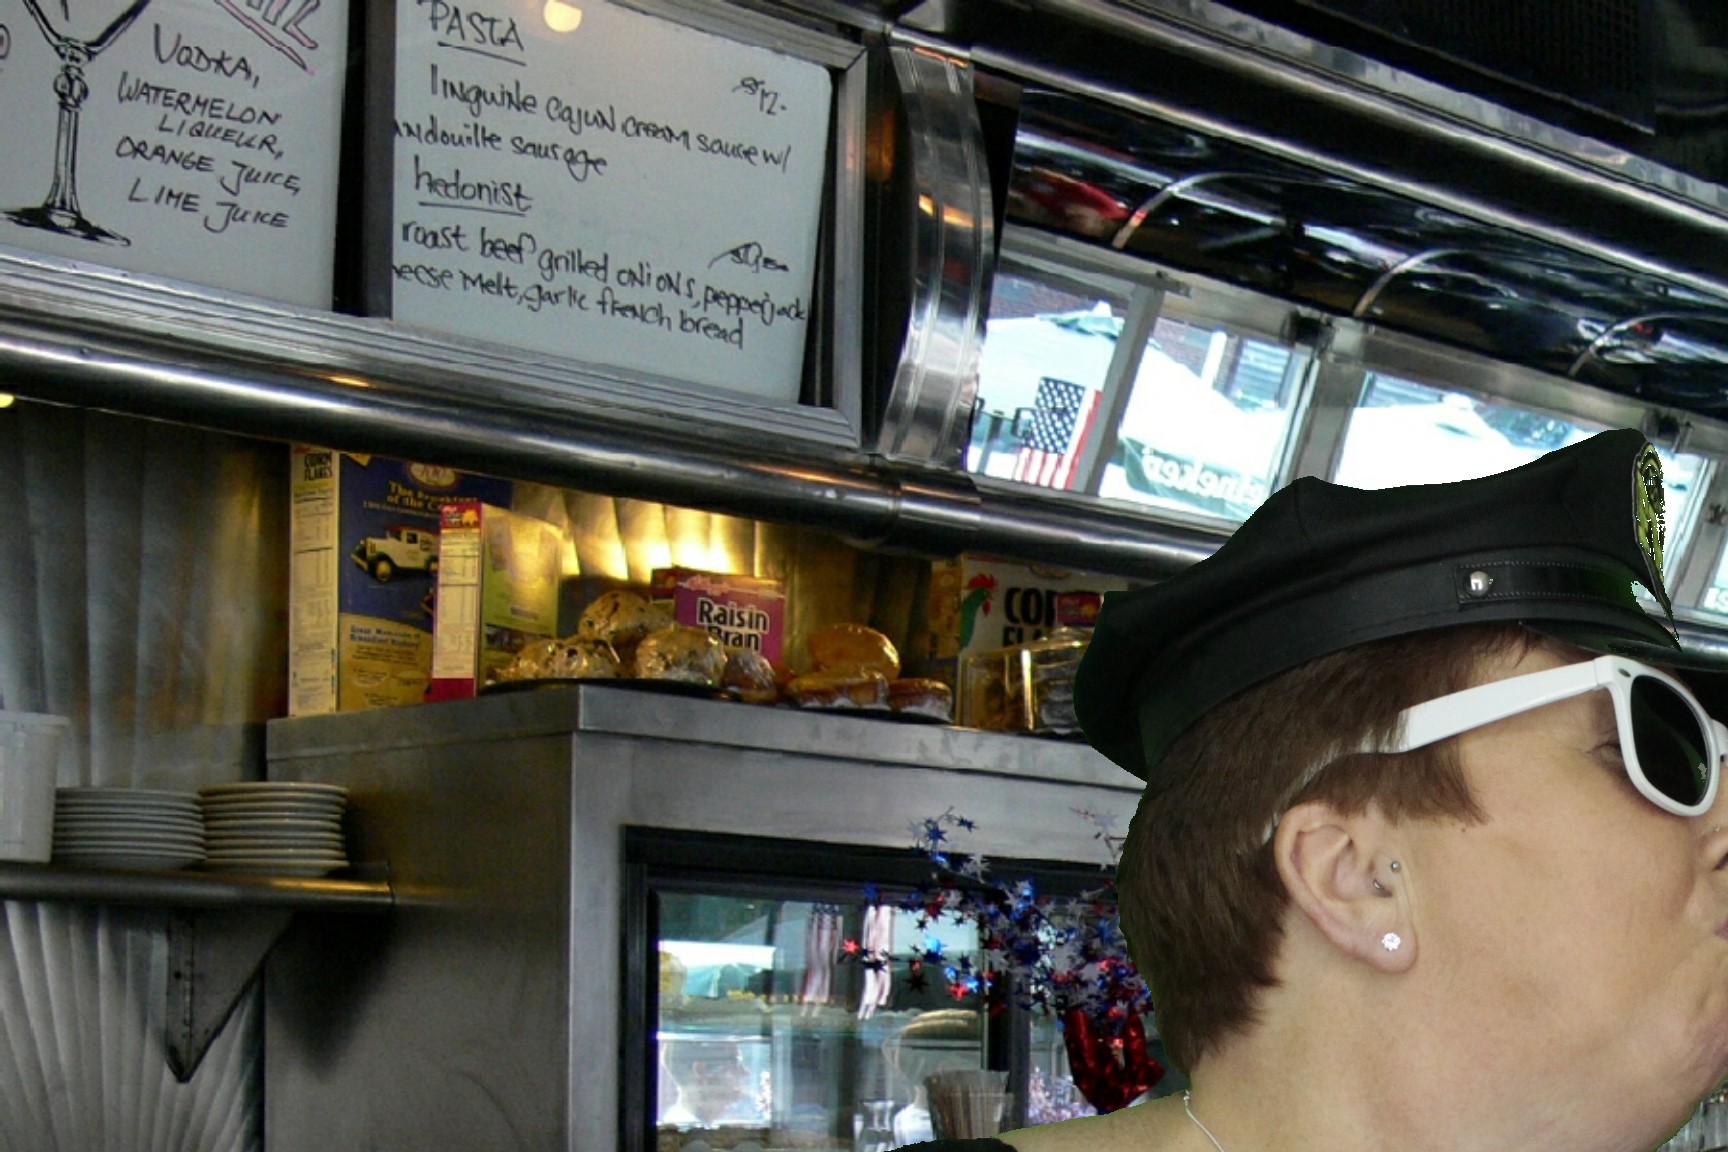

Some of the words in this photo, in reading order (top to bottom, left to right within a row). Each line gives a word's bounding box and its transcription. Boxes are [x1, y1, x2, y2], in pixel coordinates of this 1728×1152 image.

[417, 0, 525, 50] PASTA
[118, 72, 282, 125] WATERMELON
[116, 136, 214, 173] ORANGE
[159, 114, 283, 158] LIQUEUR,
[129, 178, 200, 213] LIME
[205, 200, 290, 234] JUICE
[414, 154, 533, 212] hedonist
[402, 220, 469, 250] roast
[481, 226, 537, 264] beef
[539, 248, 609, 283] grilled
[680, 309, 744, 350] bread
[697, 598, 770, 634] Raisin
